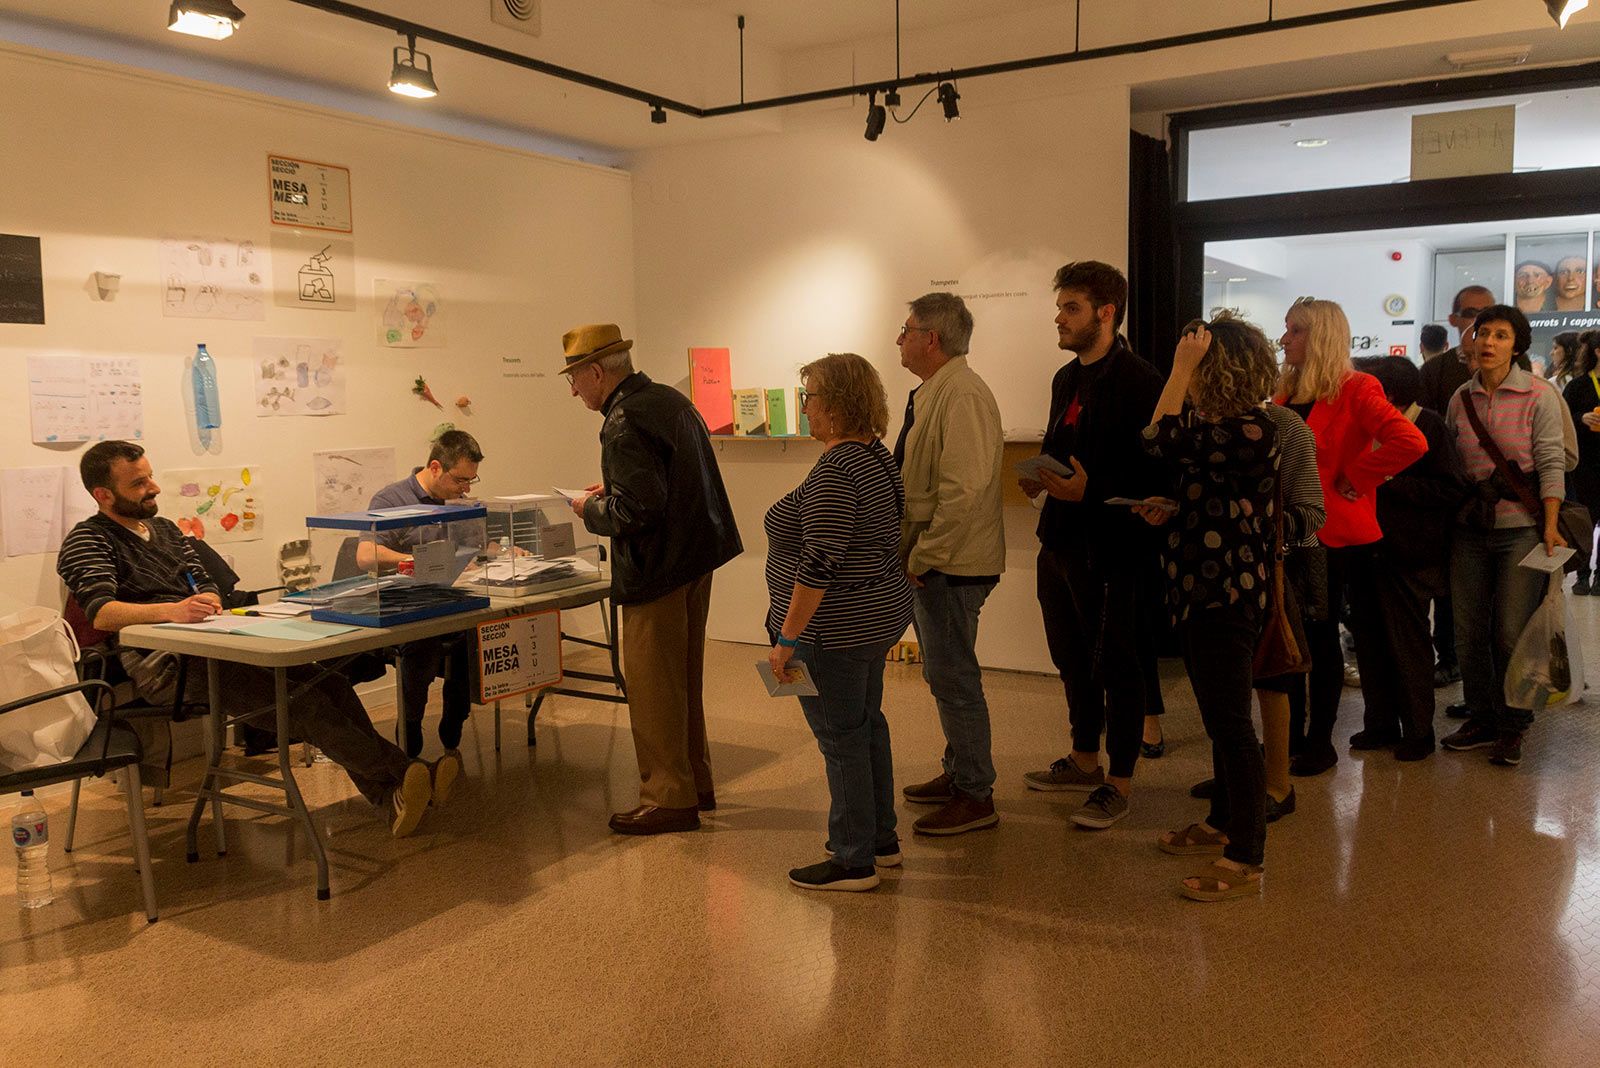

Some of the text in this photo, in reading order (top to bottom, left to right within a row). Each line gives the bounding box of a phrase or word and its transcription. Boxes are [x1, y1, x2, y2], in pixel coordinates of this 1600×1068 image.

[272, 179, 308, 194] MESA
[1529, 318, 1560, 328] arrots
[483, 644, 519, 662] MESA
[531, 641, 537, 650] 3
[484, 657, 520, 676] MESA
